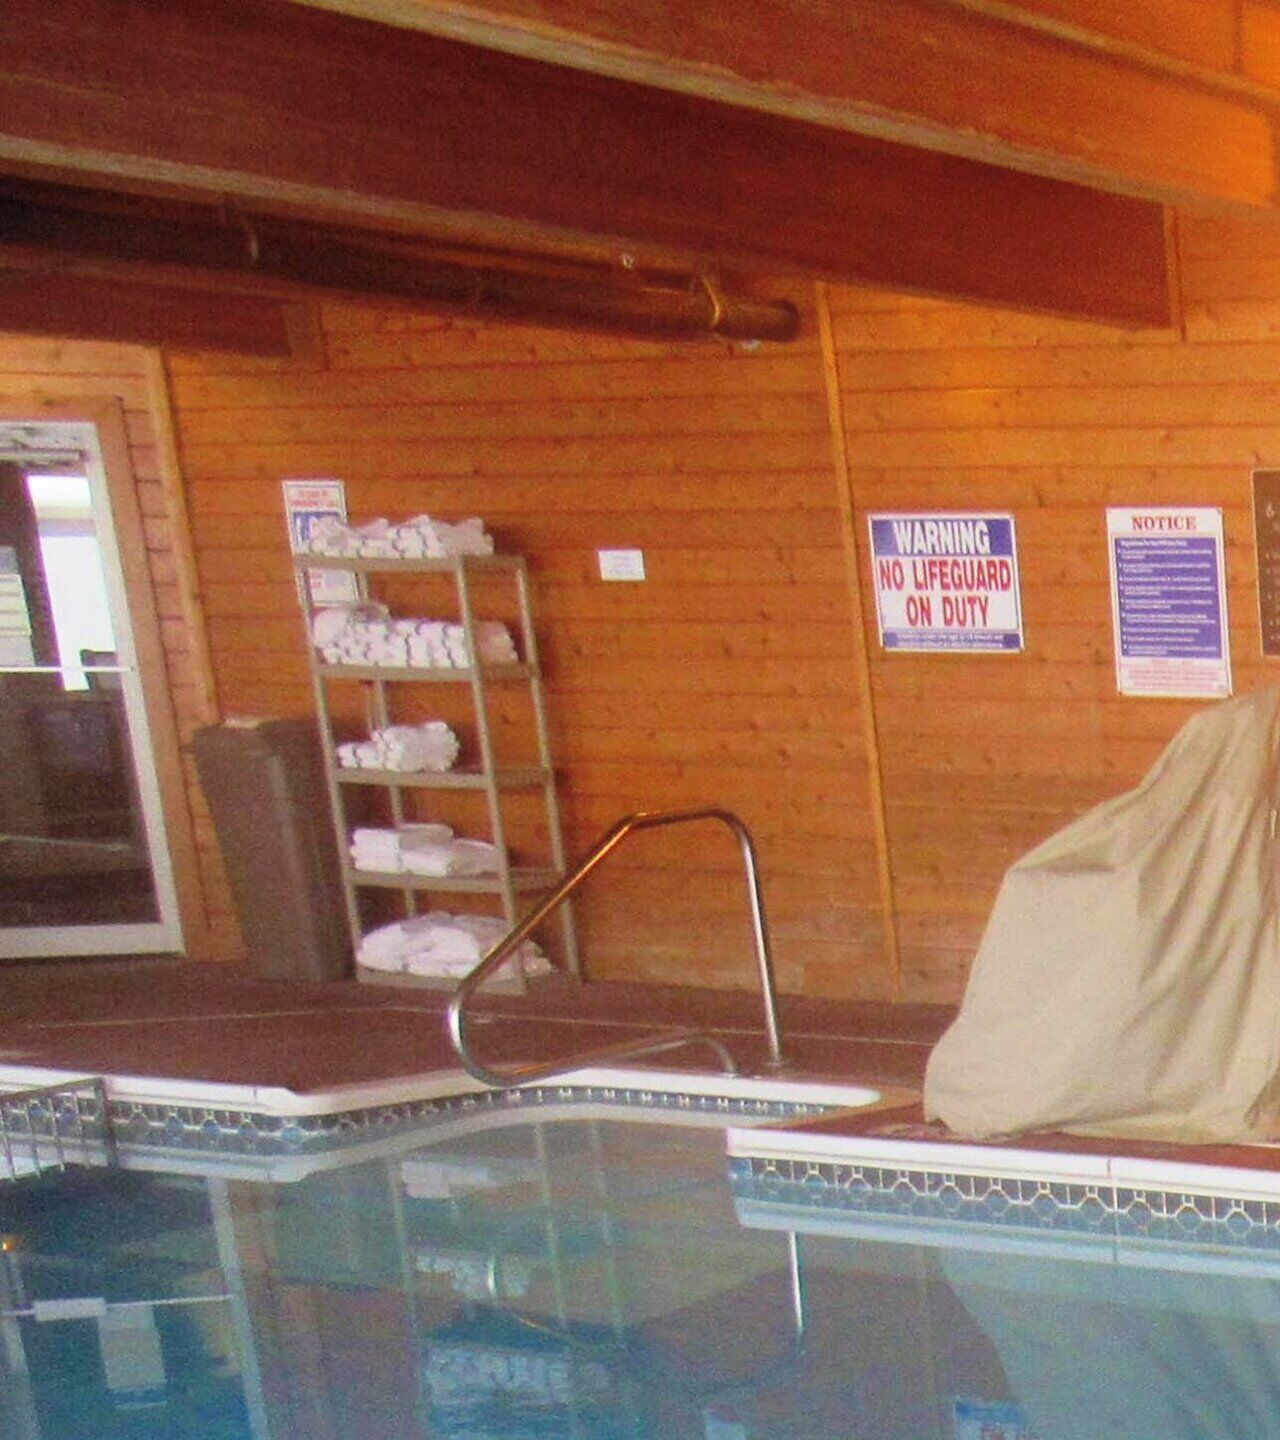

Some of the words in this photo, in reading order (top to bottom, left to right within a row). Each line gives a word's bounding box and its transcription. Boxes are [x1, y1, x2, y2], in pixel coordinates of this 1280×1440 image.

[892, 520, 991, 556] WARNING
[1131, 516, 1197, 531] NOTICE
[879, 559, 905, 591] NO
[912, 558, 1011, 592] LIFEGUARD
[905, 595, 932, 627] ON
[941, 595, 989, 627] DUTY
